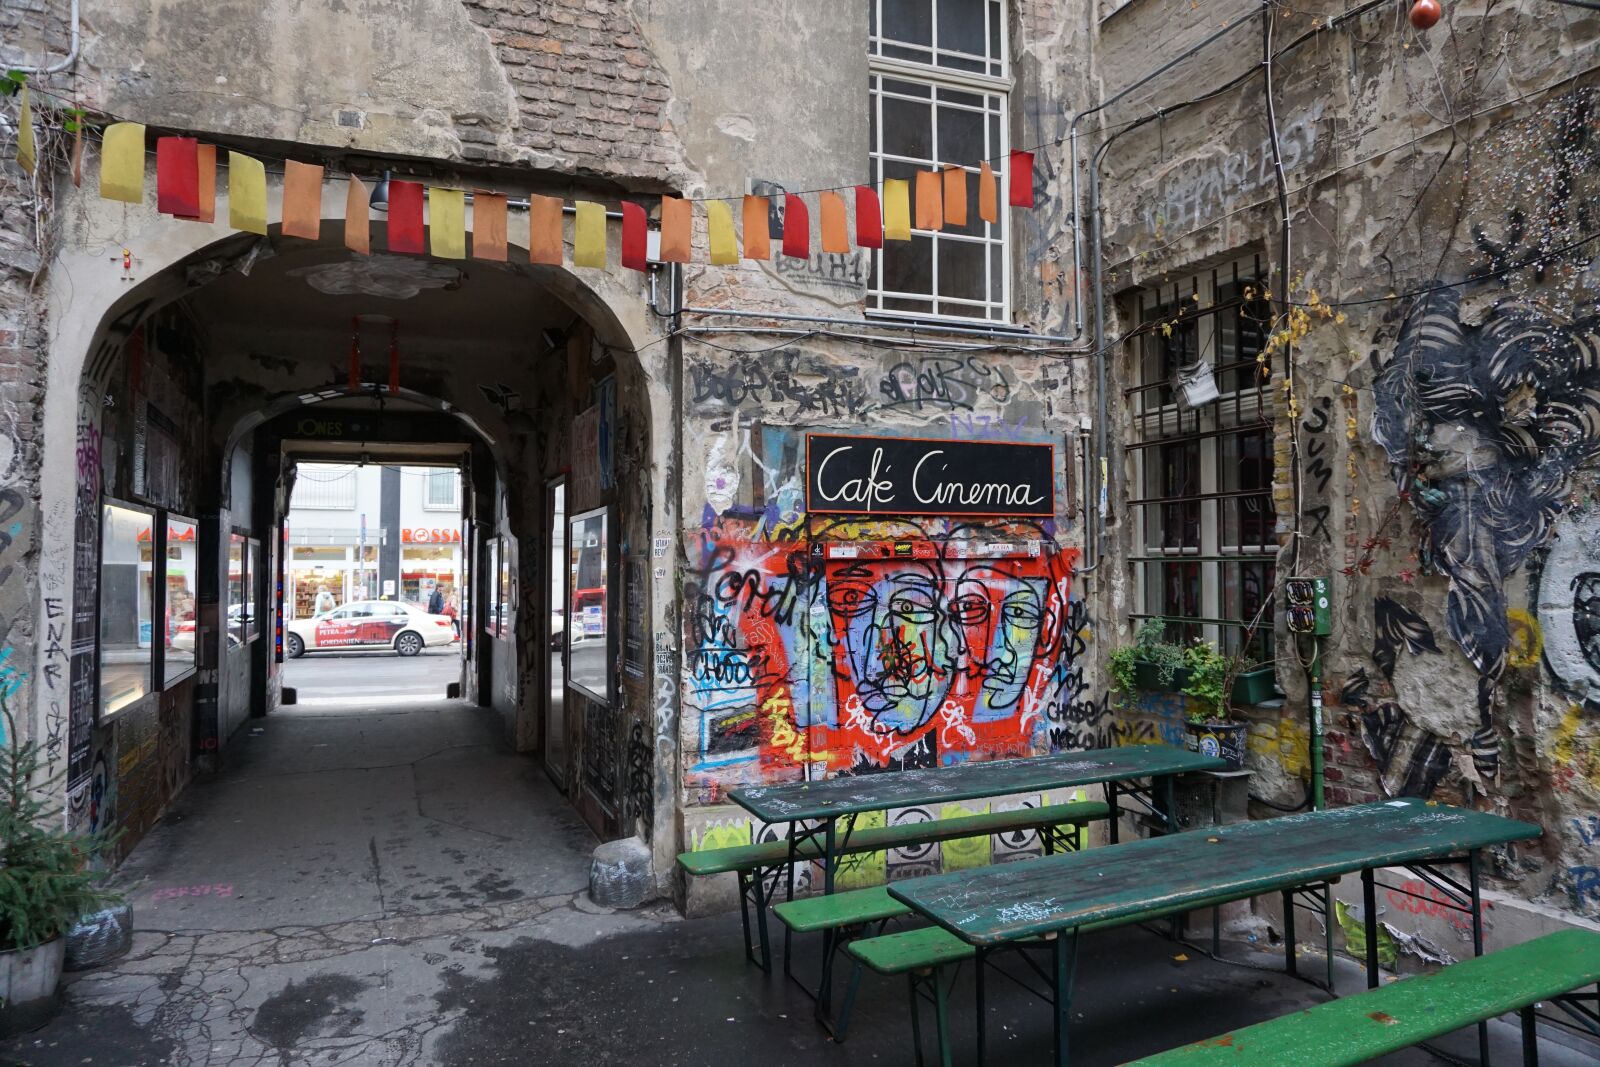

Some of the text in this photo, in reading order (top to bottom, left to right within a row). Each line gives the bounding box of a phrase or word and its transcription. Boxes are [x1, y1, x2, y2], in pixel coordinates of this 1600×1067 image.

[296, 418, 342, 436] JONES
[817, 446, 1046, 512] Café Cinema
